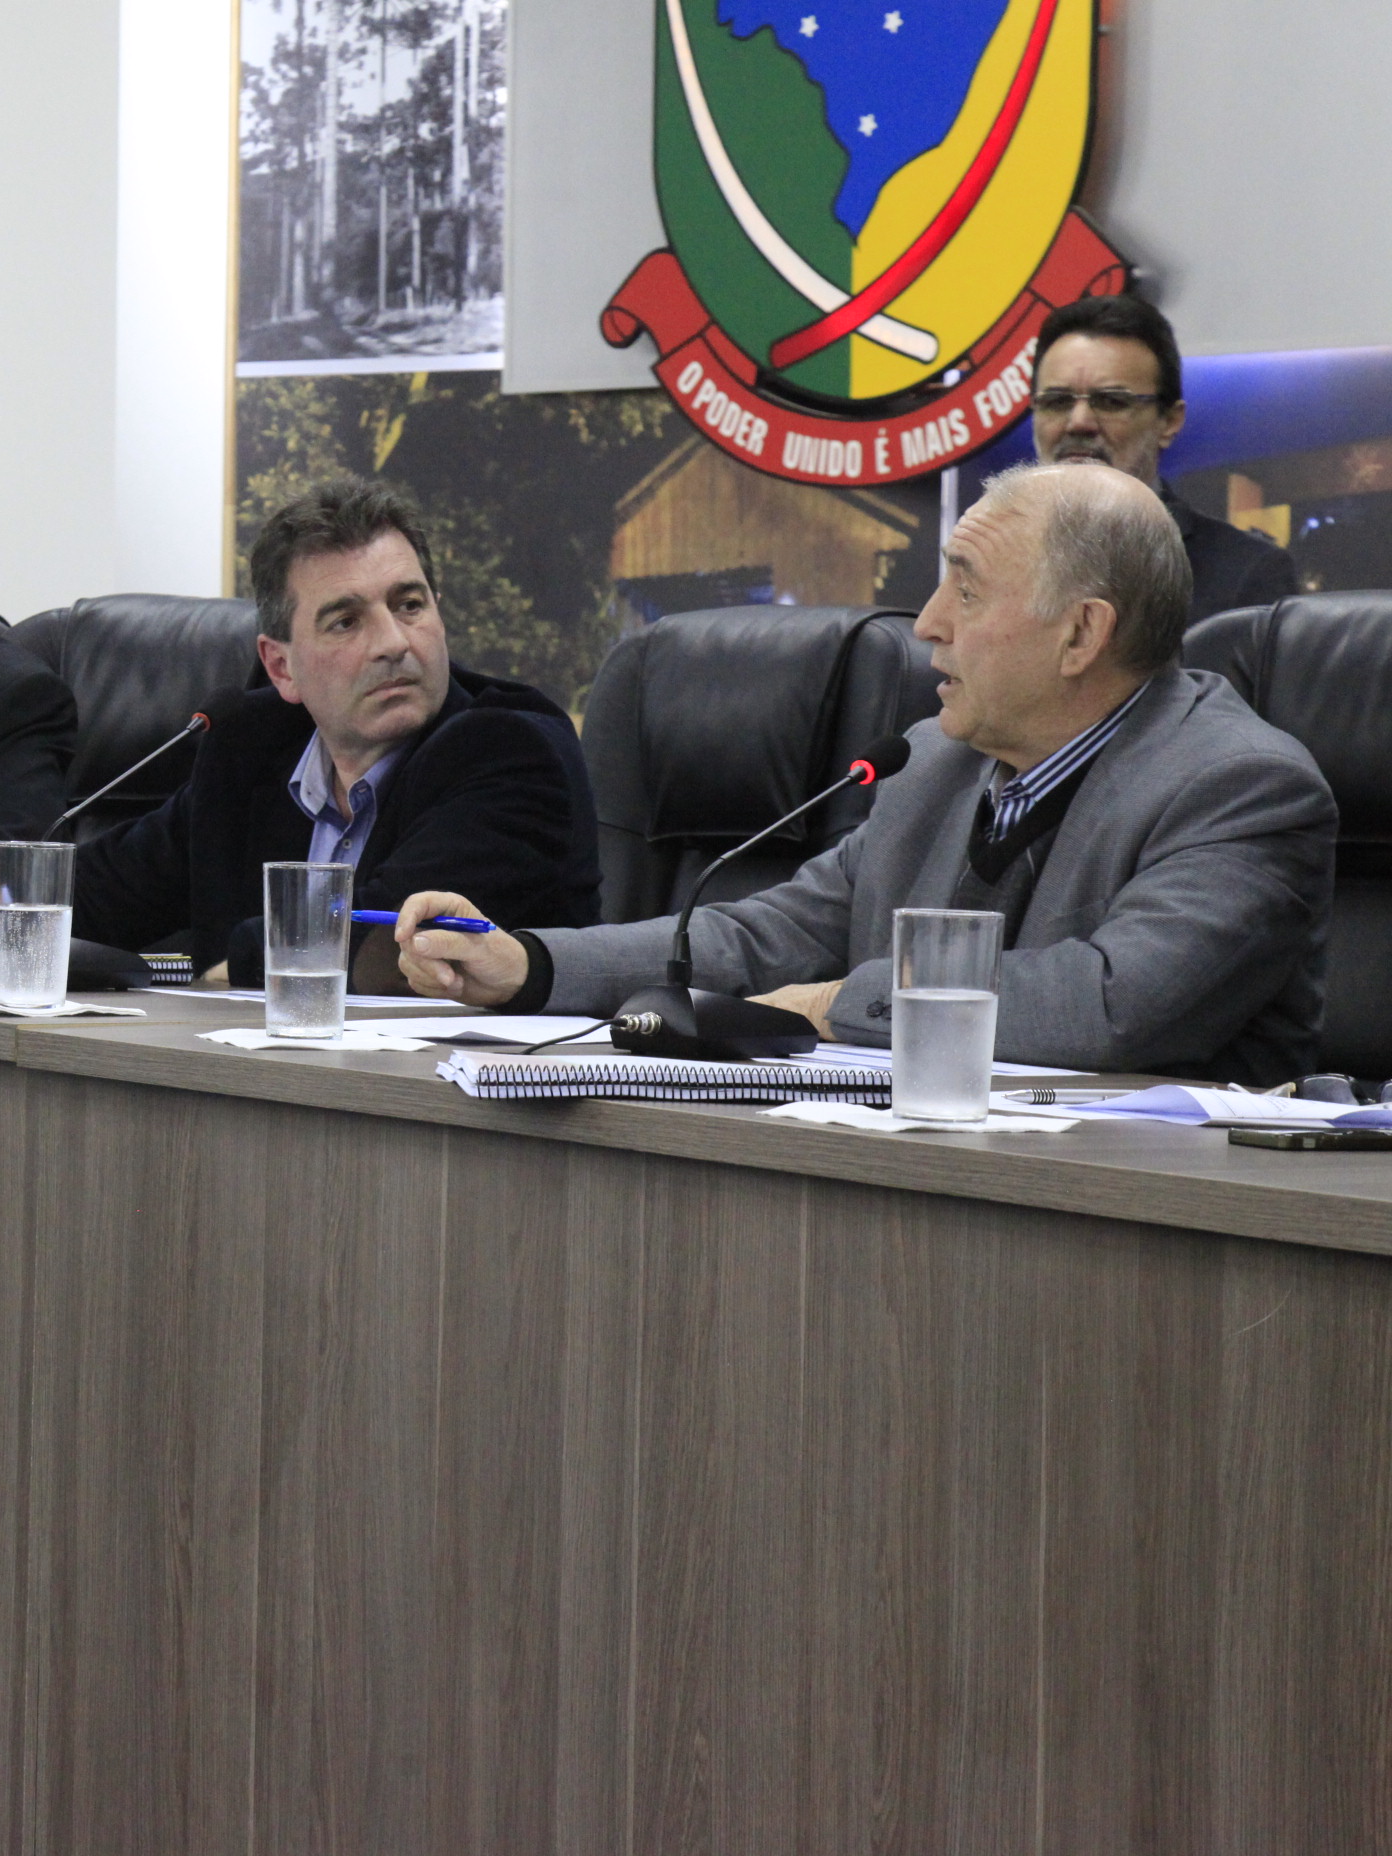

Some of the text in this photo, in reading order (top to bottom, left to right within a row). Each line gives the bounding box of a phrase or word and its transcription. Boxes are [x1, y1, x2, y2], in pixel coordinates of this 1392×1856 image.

[676, 361, 704, 395] O
[691, 378, 769, 456] PODER
[782, 431, 863, 478] UNIDO
[874, 427, 891, 475] É
[900, 408, 971, 468] MAIS
